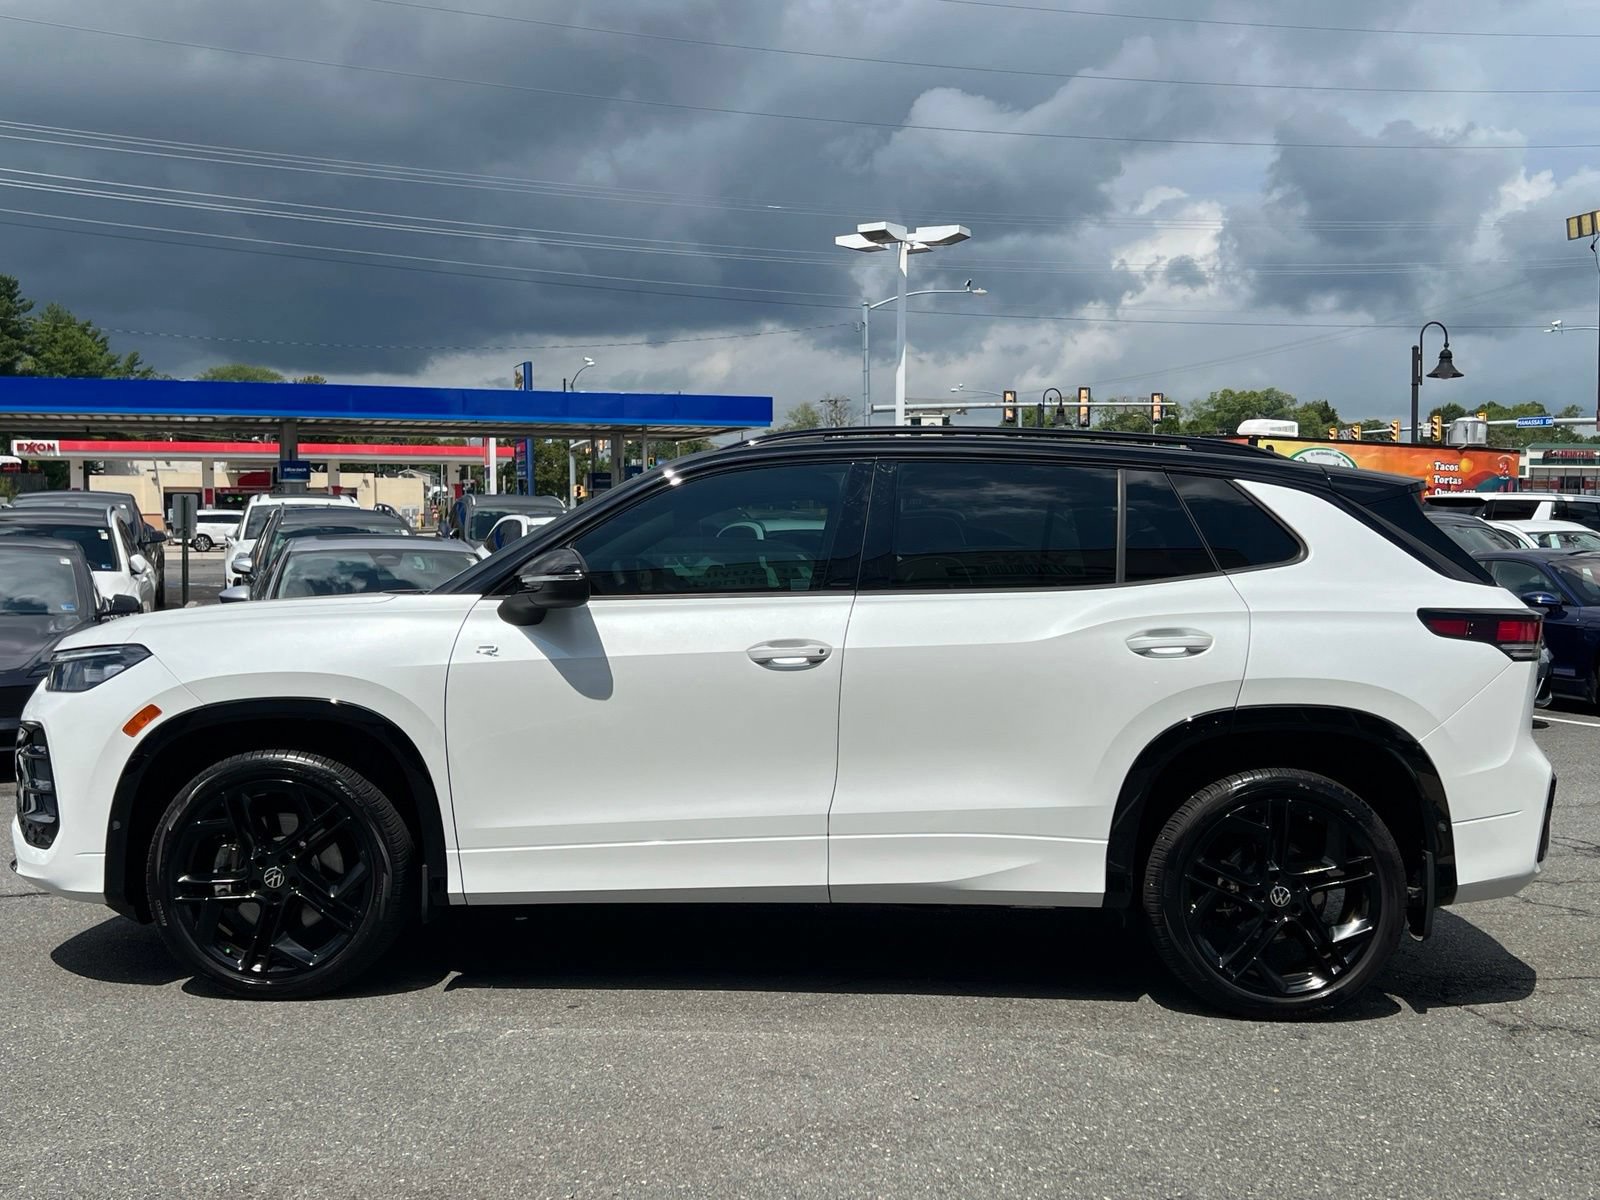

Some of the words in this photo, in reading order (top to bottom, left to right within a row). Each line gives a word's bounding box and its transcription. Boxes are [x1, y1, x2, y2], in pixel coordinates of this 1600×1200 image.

[16, 441, 56, 455] EXXON
[1434, 461, 1459, 472] Tacos
[1433, 474, 1463, 485] Tortas
